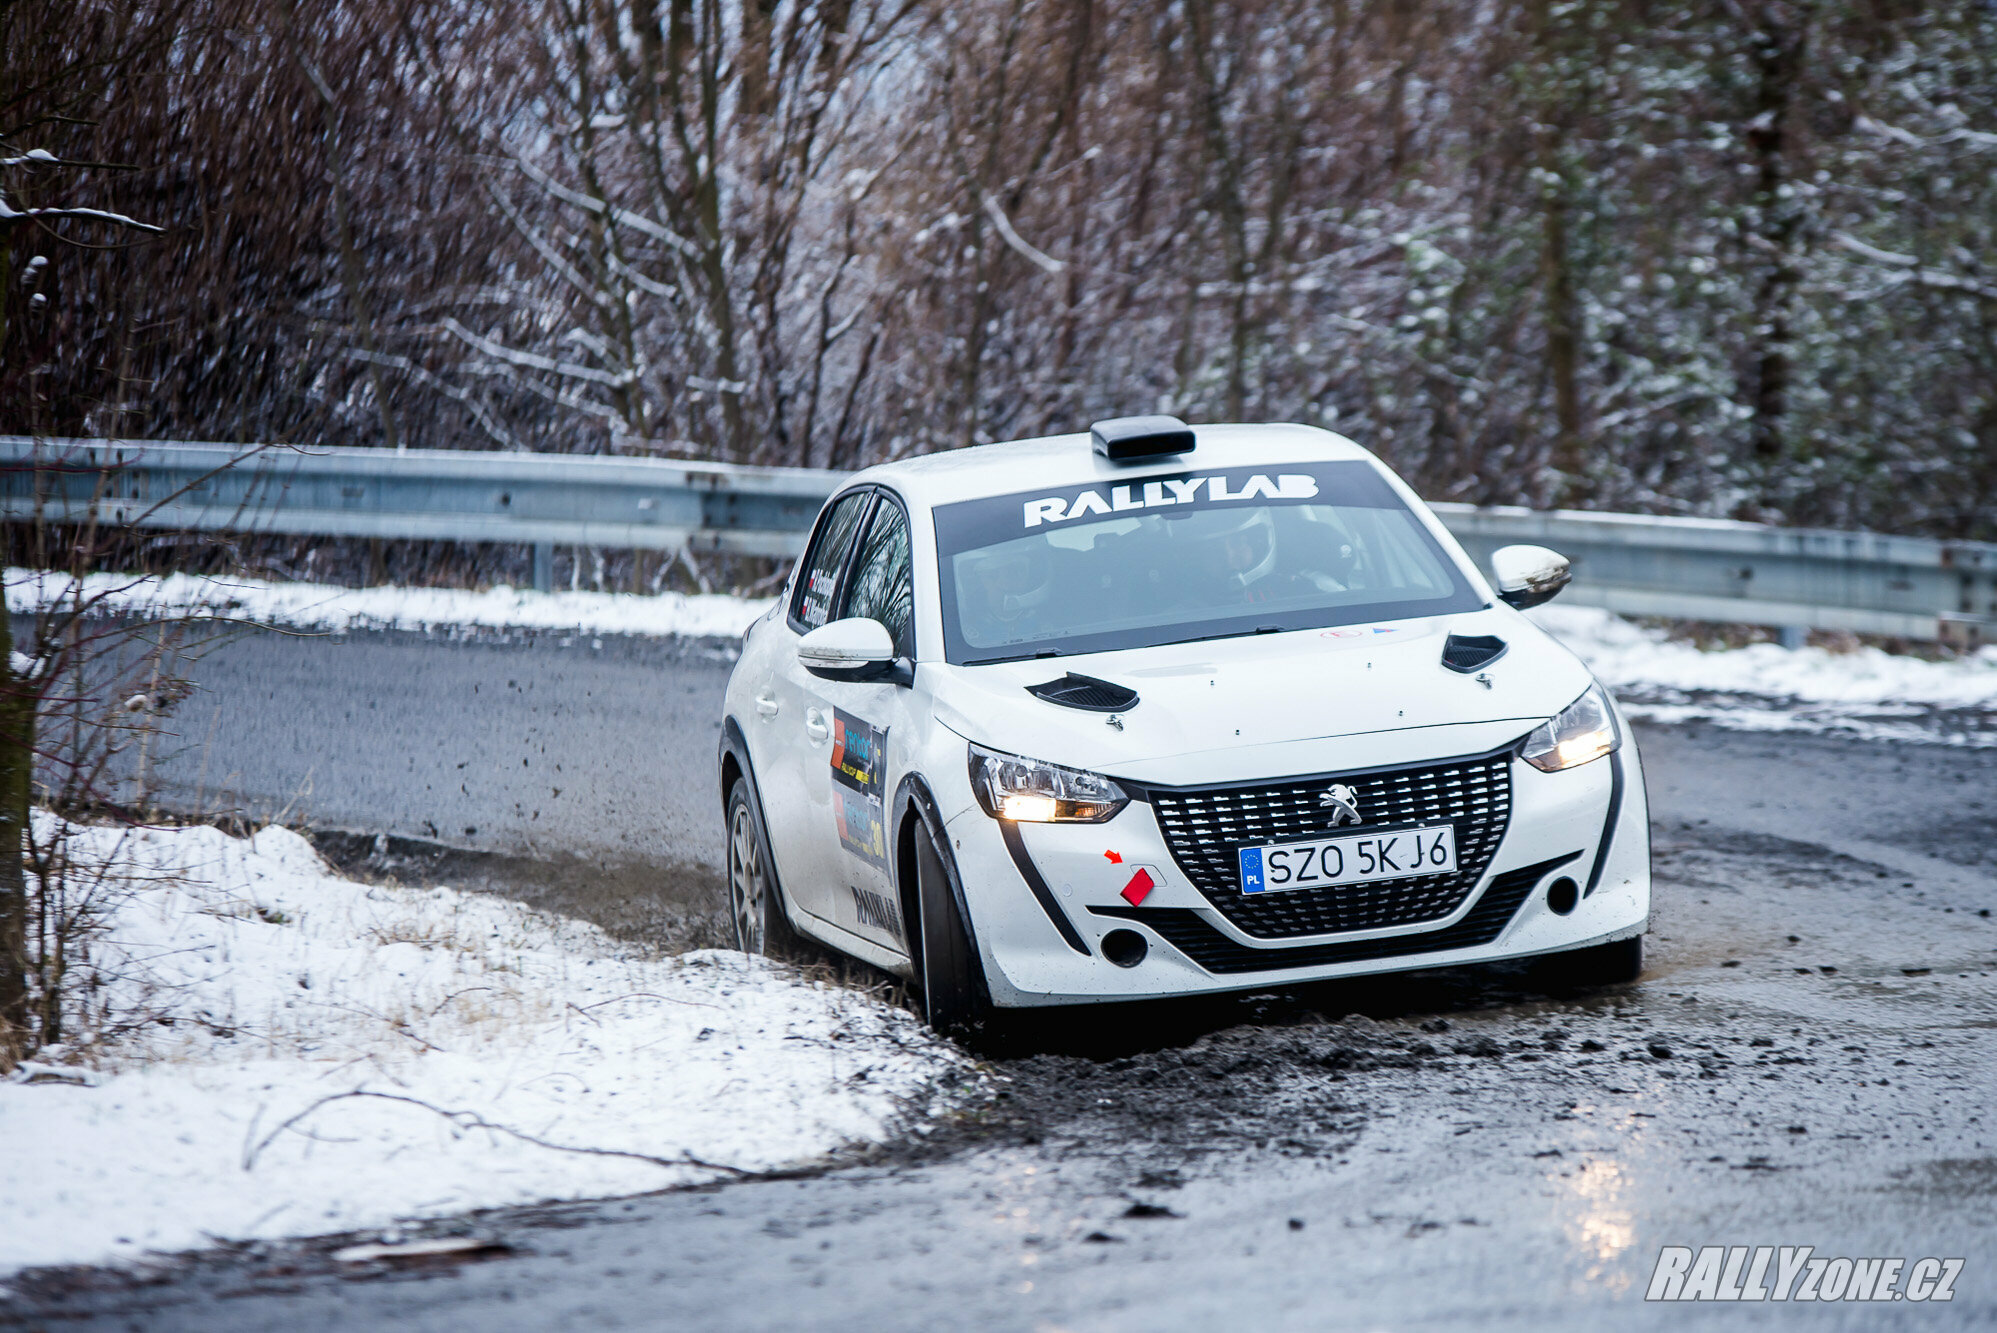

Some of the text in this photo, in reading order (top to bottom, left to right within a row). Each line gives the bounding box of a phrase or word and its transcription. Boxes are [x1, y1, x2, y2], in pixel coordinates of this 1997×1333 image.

[1023, 474, 1320, 528] RALLYLAB
[1246, 875, 1260, 886] PL
[1267, 844, 1344, 884] SZO
